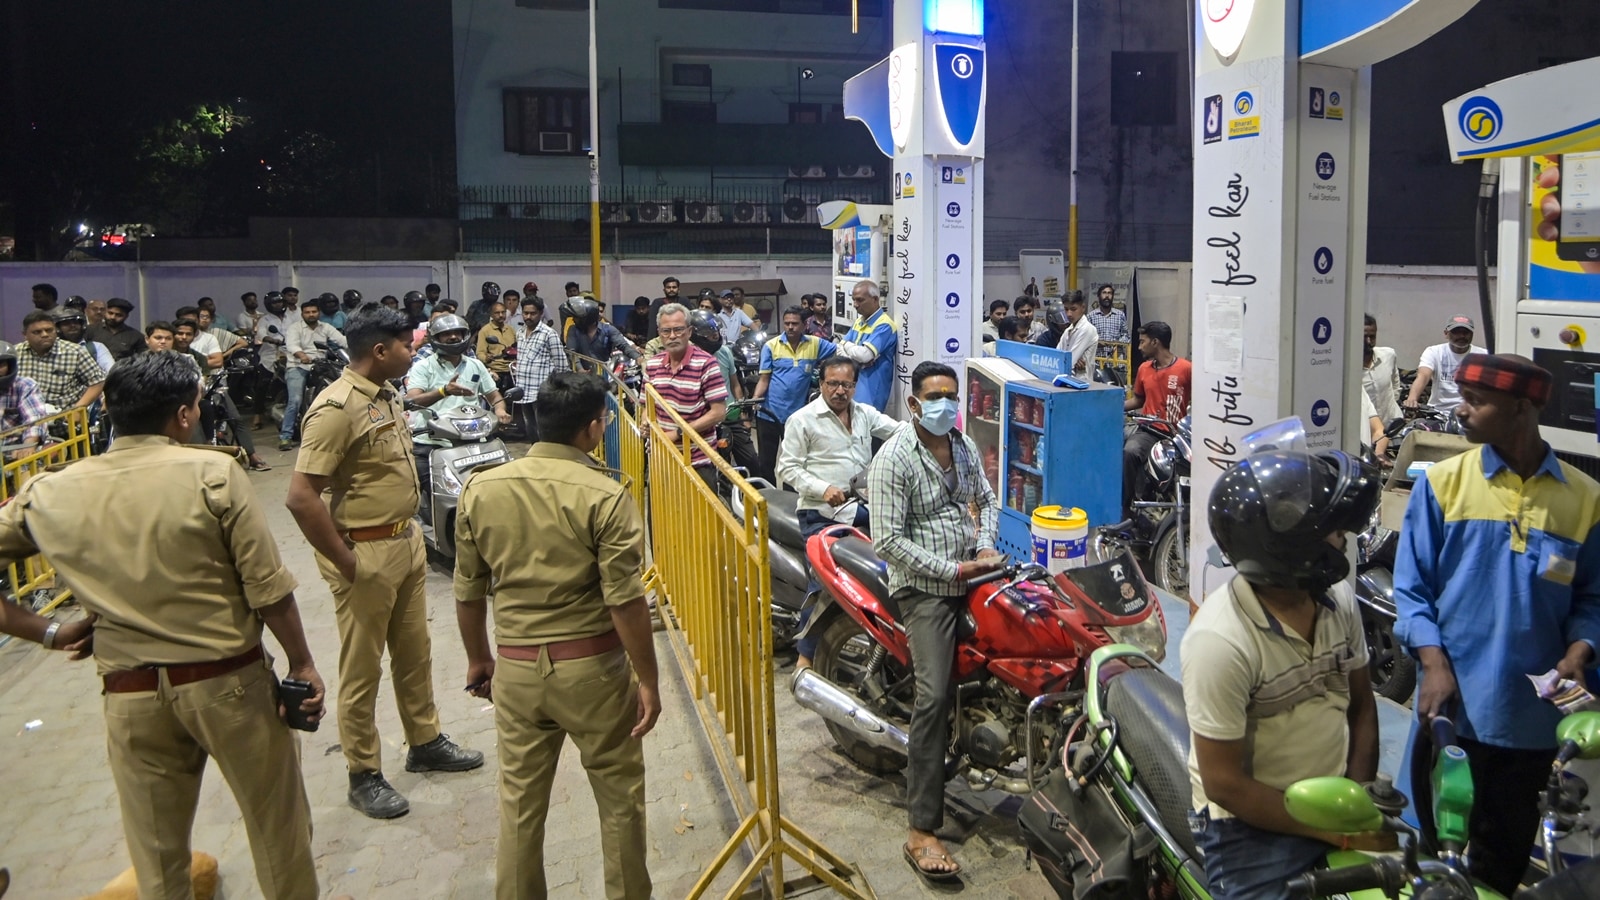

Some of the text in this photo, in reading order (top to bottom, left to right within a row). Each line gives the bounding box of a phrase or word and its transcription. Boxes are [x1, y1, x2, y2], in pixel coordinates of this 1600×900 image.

[1313, 182, 1337, 192] New-age
[1308, 192, 1341, 202] Fuel Stations
[897, 249, 915, 279] feel
[1207, 231, 1257, 286] feel
[1312, 277, 1334, 286] Pure fuel
[897, 286, 911, 304] ko
[1040, 355, 1060, 370] MAK
[1310, 356, 1332, 366] Quantity
[897, 363, 912, 384] Ab
[1305, 427, 1336, 438] amper-proof
[1204, 436, 1236, 471] Ab
